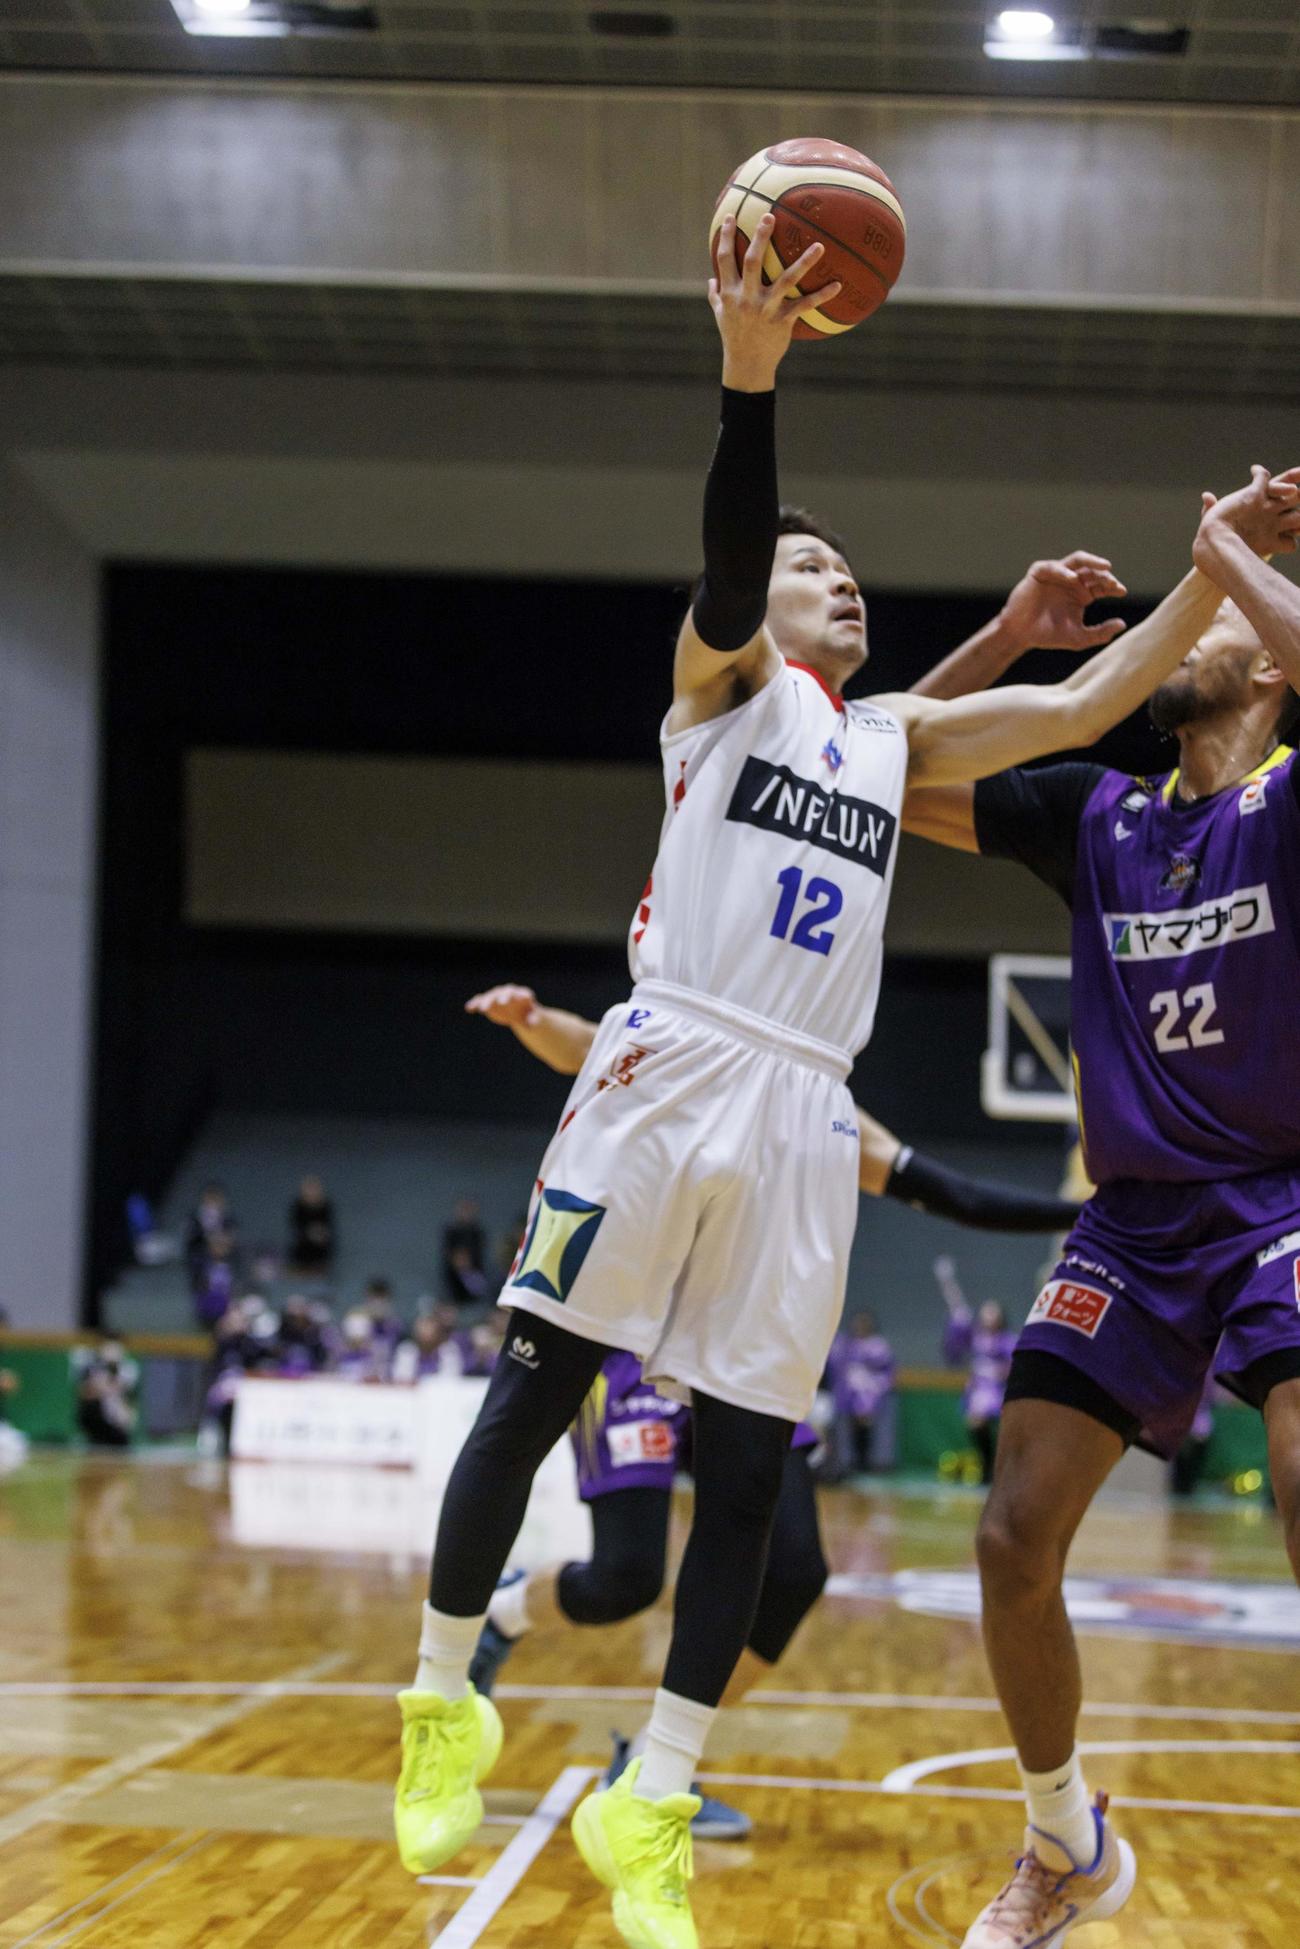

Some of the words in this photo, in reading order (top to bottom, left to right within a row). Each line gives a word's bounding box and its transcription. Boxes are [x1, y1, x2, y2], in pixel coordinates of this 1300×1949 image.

[751, 775, 885, 858] INFLUX
[770, 866, 843, 956] 12
[1135, 898, 1259, 953] ヤマザワ
[1150, 982, 1224, 1053] 22
